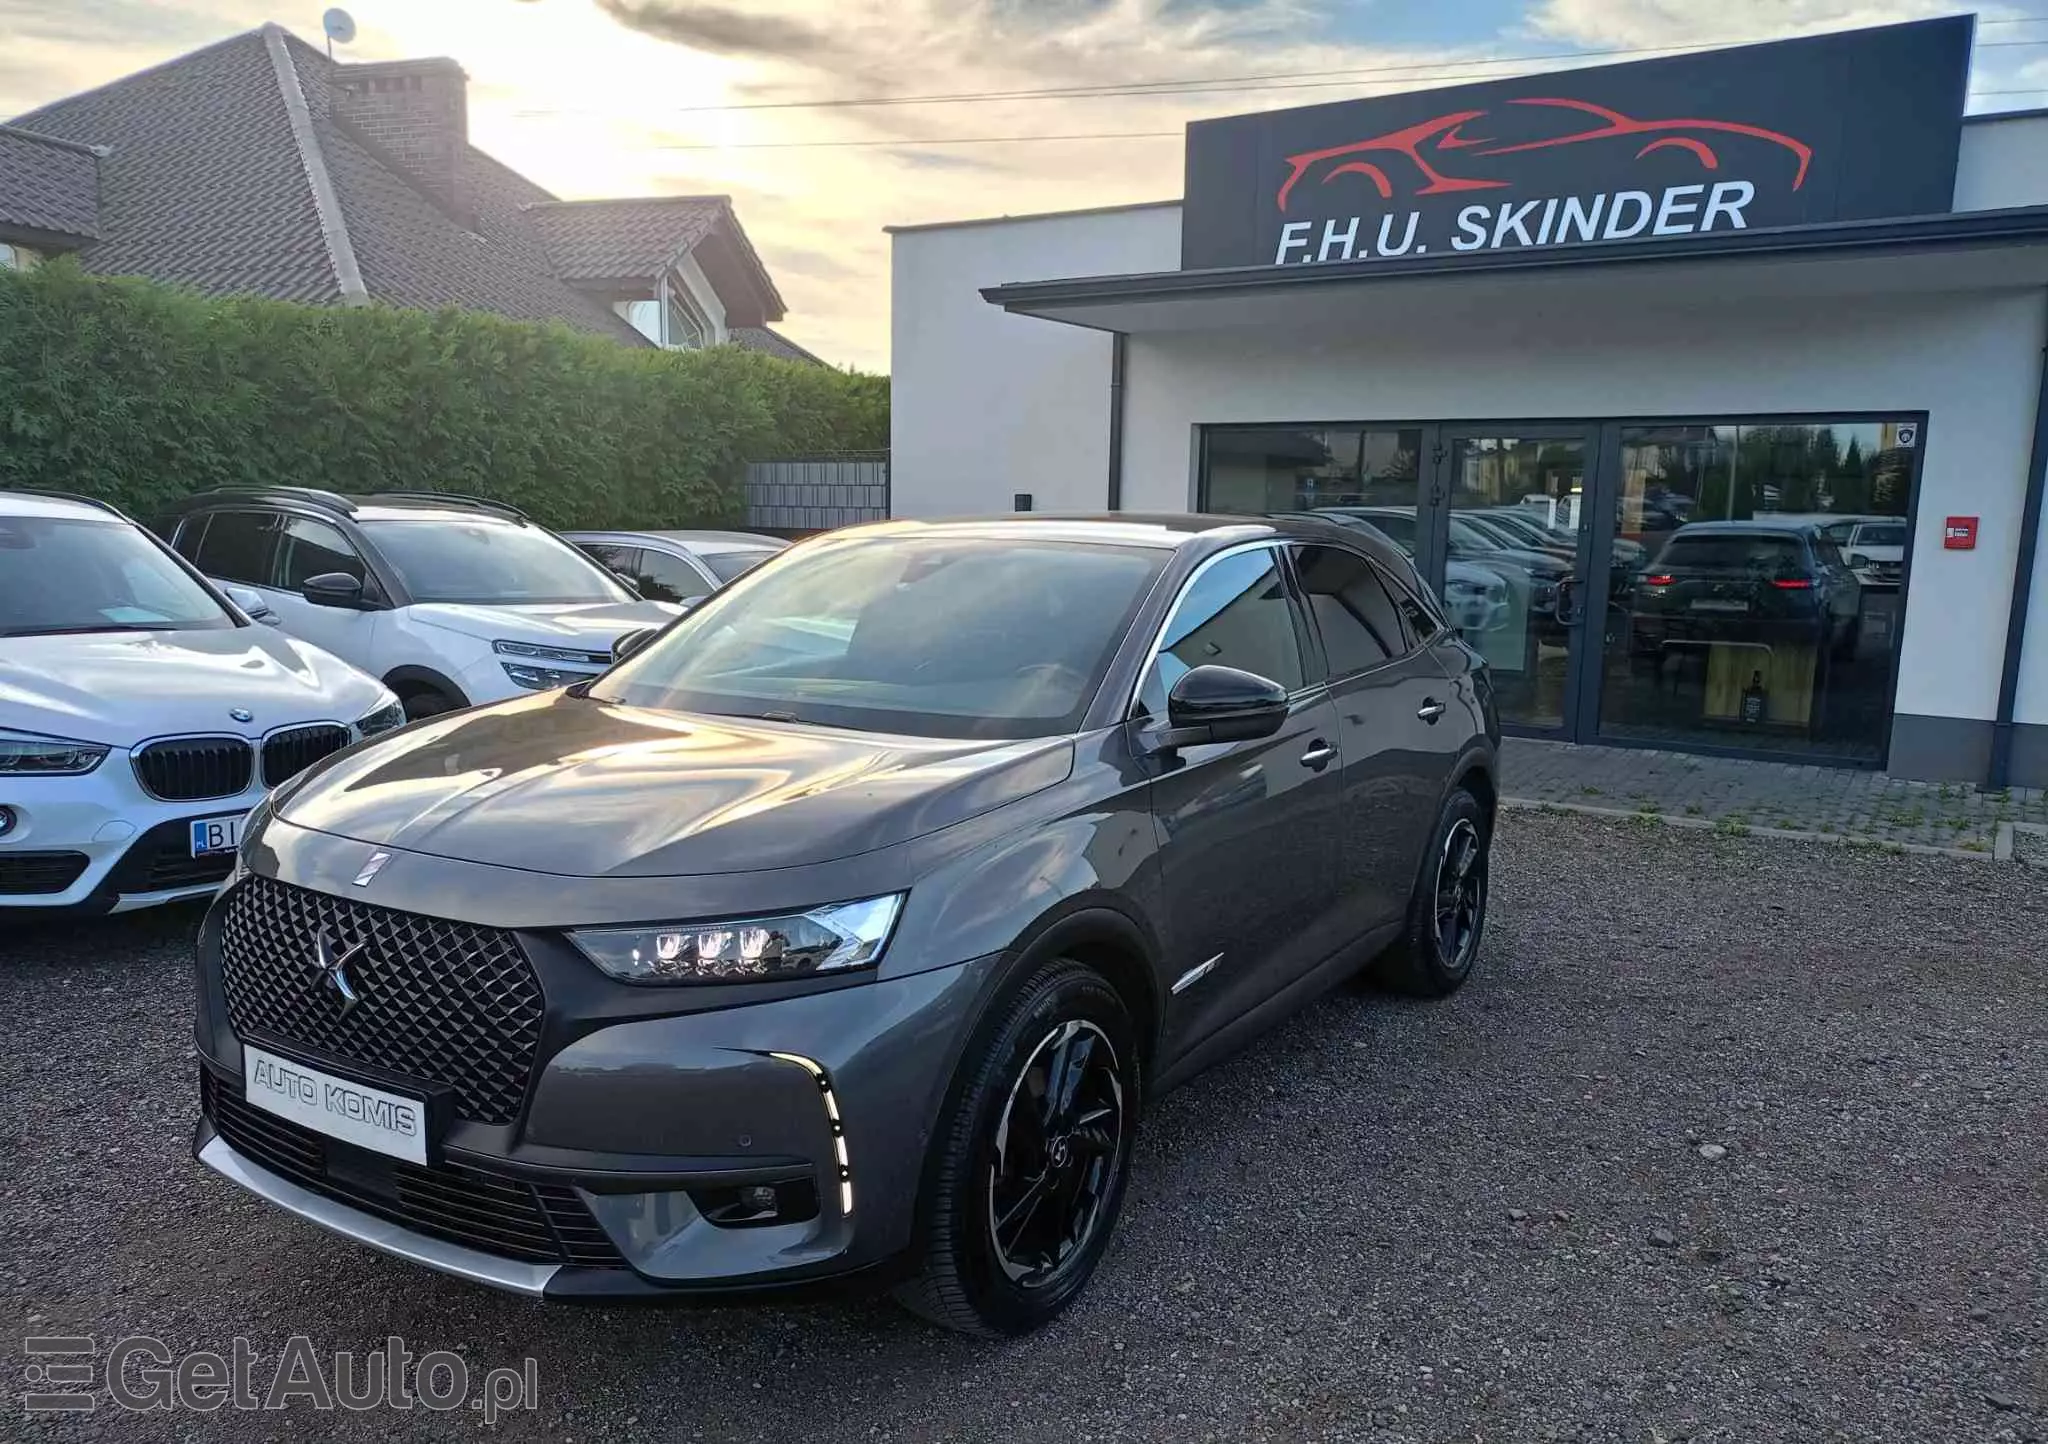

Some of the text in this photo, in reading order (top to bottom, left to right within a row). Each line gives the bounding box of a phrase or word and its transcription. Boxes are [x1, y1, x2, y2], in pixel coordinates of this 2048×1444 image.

[1275, 181, 1755, 265] F.H.U. SKINDER
[254, 1060, 417, 1136] AUTO KOMIS
